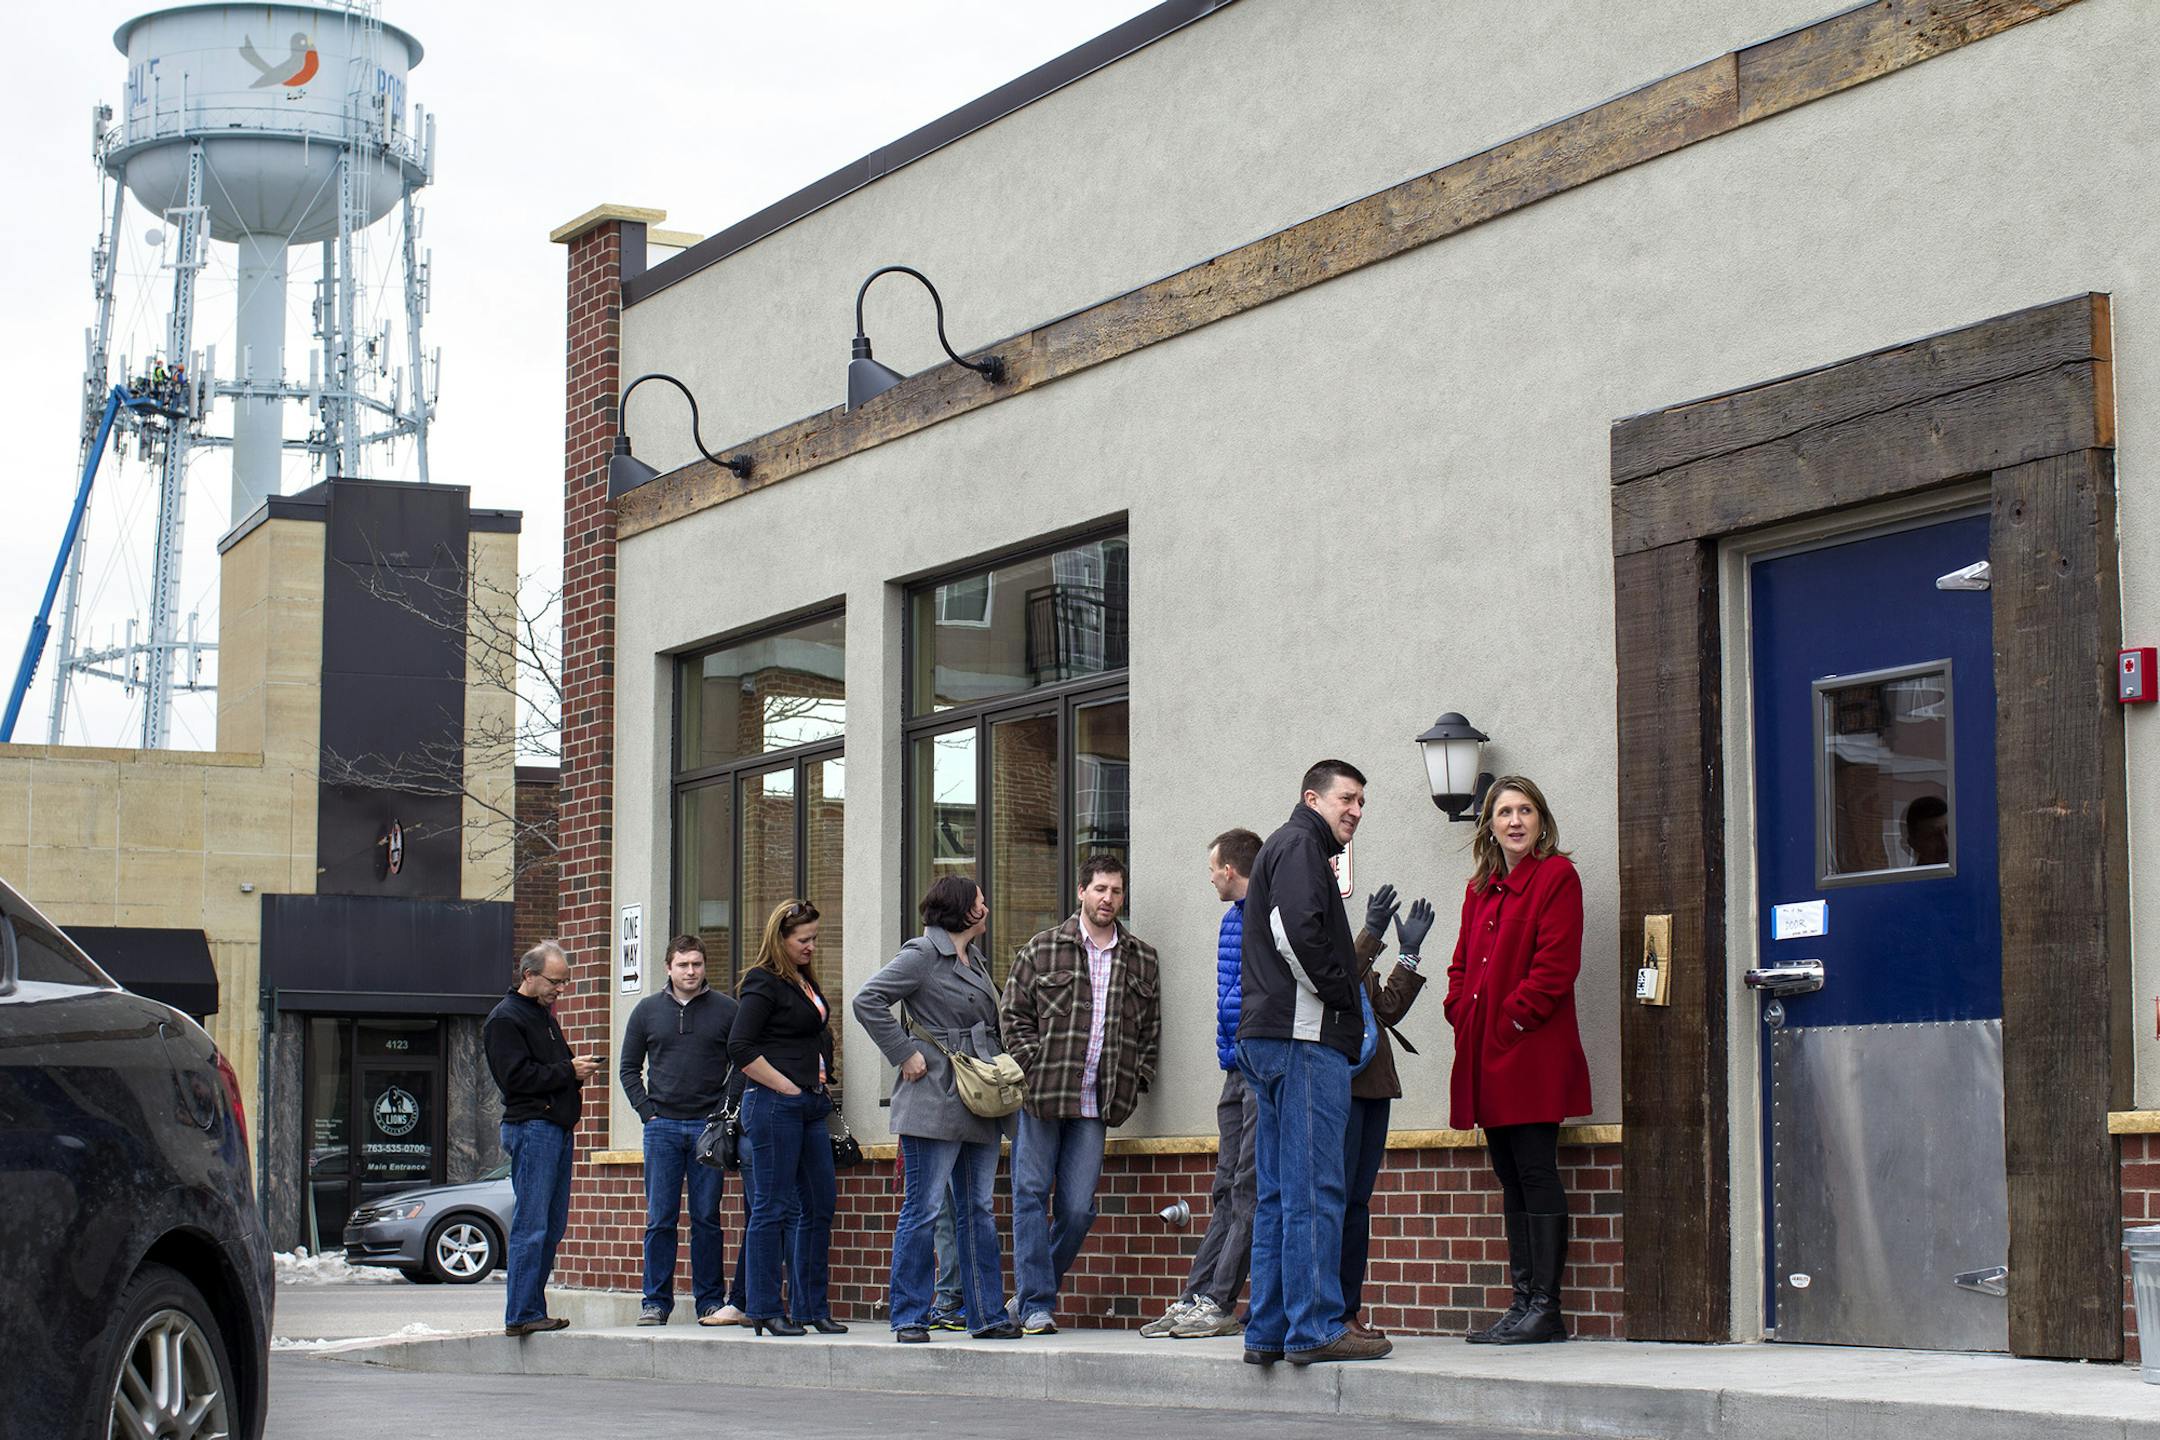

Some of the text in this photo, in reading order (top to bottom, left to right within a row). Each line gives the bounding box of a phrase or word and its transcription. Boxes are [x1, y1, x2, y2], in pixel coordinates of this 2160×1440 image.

[623, 915, 639, 941] ONE
[623, 943, 639, 968] WAY
[385, 1039, 409, 1050] 4123
[385, 1113, 407, 1125] LIONS
[367, 1144, 426, 1153] 763-535-0700
[367, 1162, 426, 1171] Main Entrance
